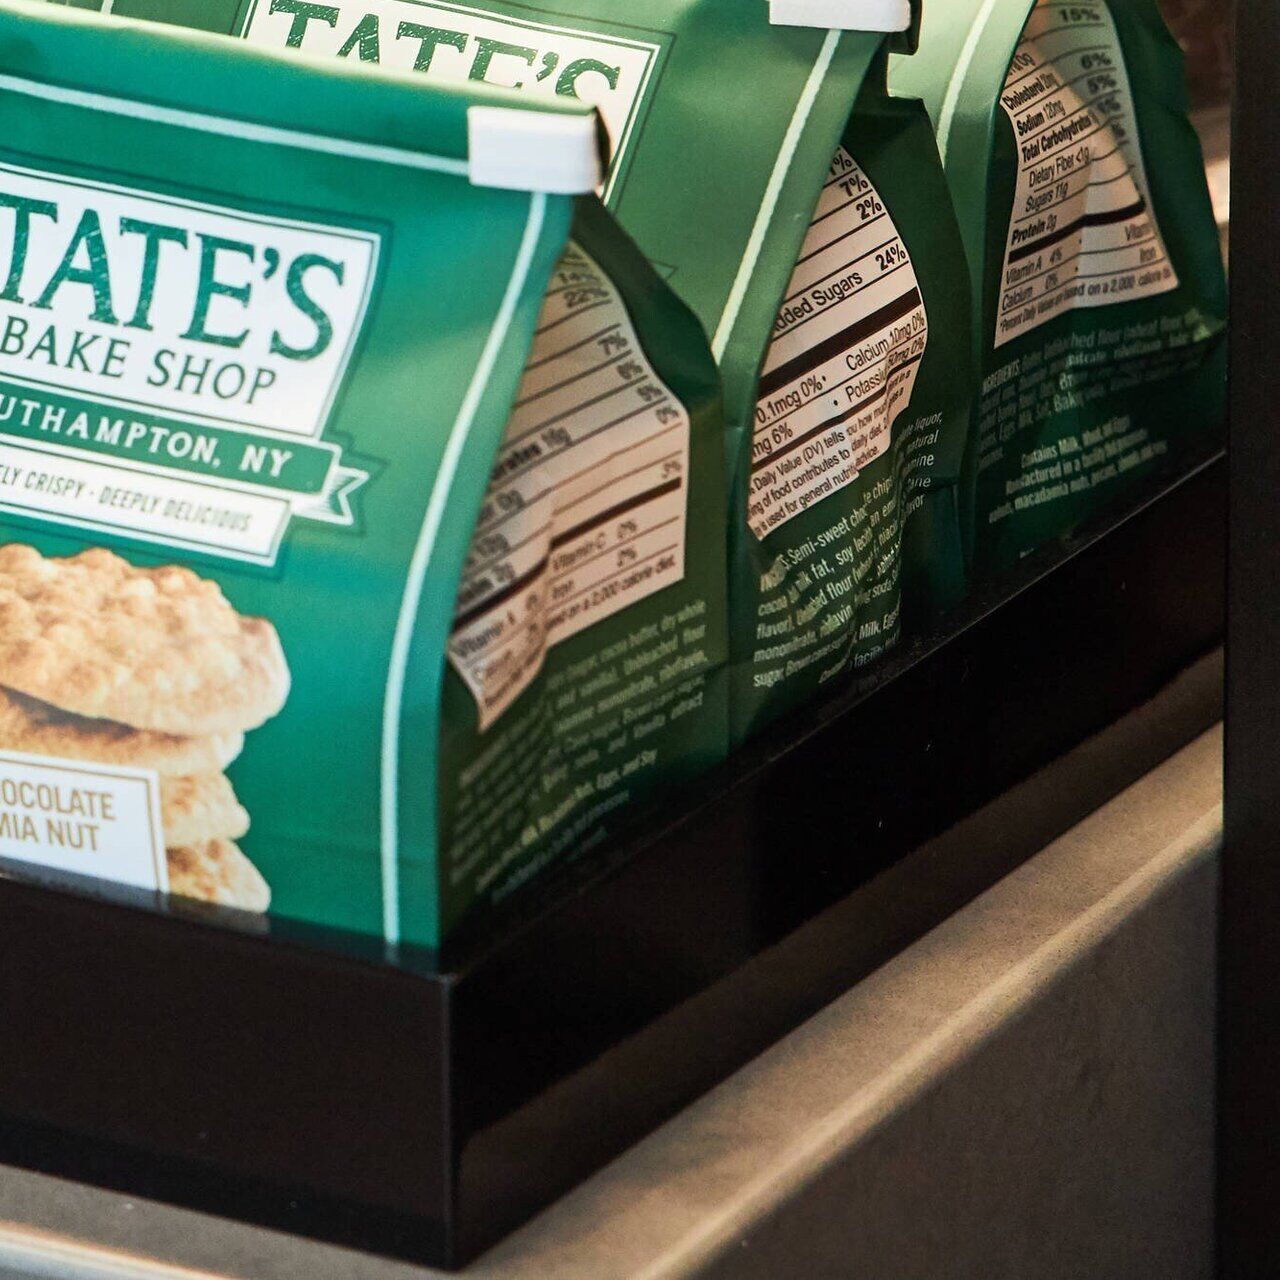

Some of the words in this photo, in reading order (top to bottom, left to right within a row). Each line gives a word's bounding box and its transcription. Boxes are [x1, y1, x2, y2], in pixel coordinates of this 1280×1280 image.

[1002, 78, 1045, 110] Cholesterol
[1016, 112, 1046, 137] Sodium
[1021, 142, 1040, 163] Total
[839, 173, 869, 197] 7%
[1028, 164, 1055, 187] Dietary
[856, 196, 882, 221] 2%
[1025, 187, 1054, 212] Sugars
[1011, 222, 1046, 246] Protein
[812, 271, 863, 306] Sugars
[875, 243, 906, 271] 24%
[1006, 261, 1035, 284] Vitamin
[1002, 287, 1033, 311] Calcium
[146, 339, 277, 407] SHOP
[757, 387, 801, 424] 0.1mcg
[800, 375, 823, 398] 0%
[845, 337, 889, 371] Calcium
[912, 311, 924, 331] 0%
[772, 421, 794, 444] 6%
[237, 444, 295, 480] NY
[753, 471, 777, 491] Daily
[776, 456, 802, 476] Value
[802, 441, 824, 464] (DV)
[823, 431, 845, 449] tells
[770, 481, 792, 501] food
[791, 454, 840, 489] contributes
[851, 433, 869, 452] daily
[25, 471, 88, 500] CRISPY
[99, 485, 161, 513] DEEPLY
[163, 498, 254, 532] DELICIOUS
[766, 506, 786, 527] used
[798, 478, 833, 509] general
[787, 516, 851, 566] Semi-sweet
[811, 559, 835, 580] fat,
[835, 545, 854, 566] soy
[826, 575, 853, 600] flour
[46, 819, 100, 852] NUT
